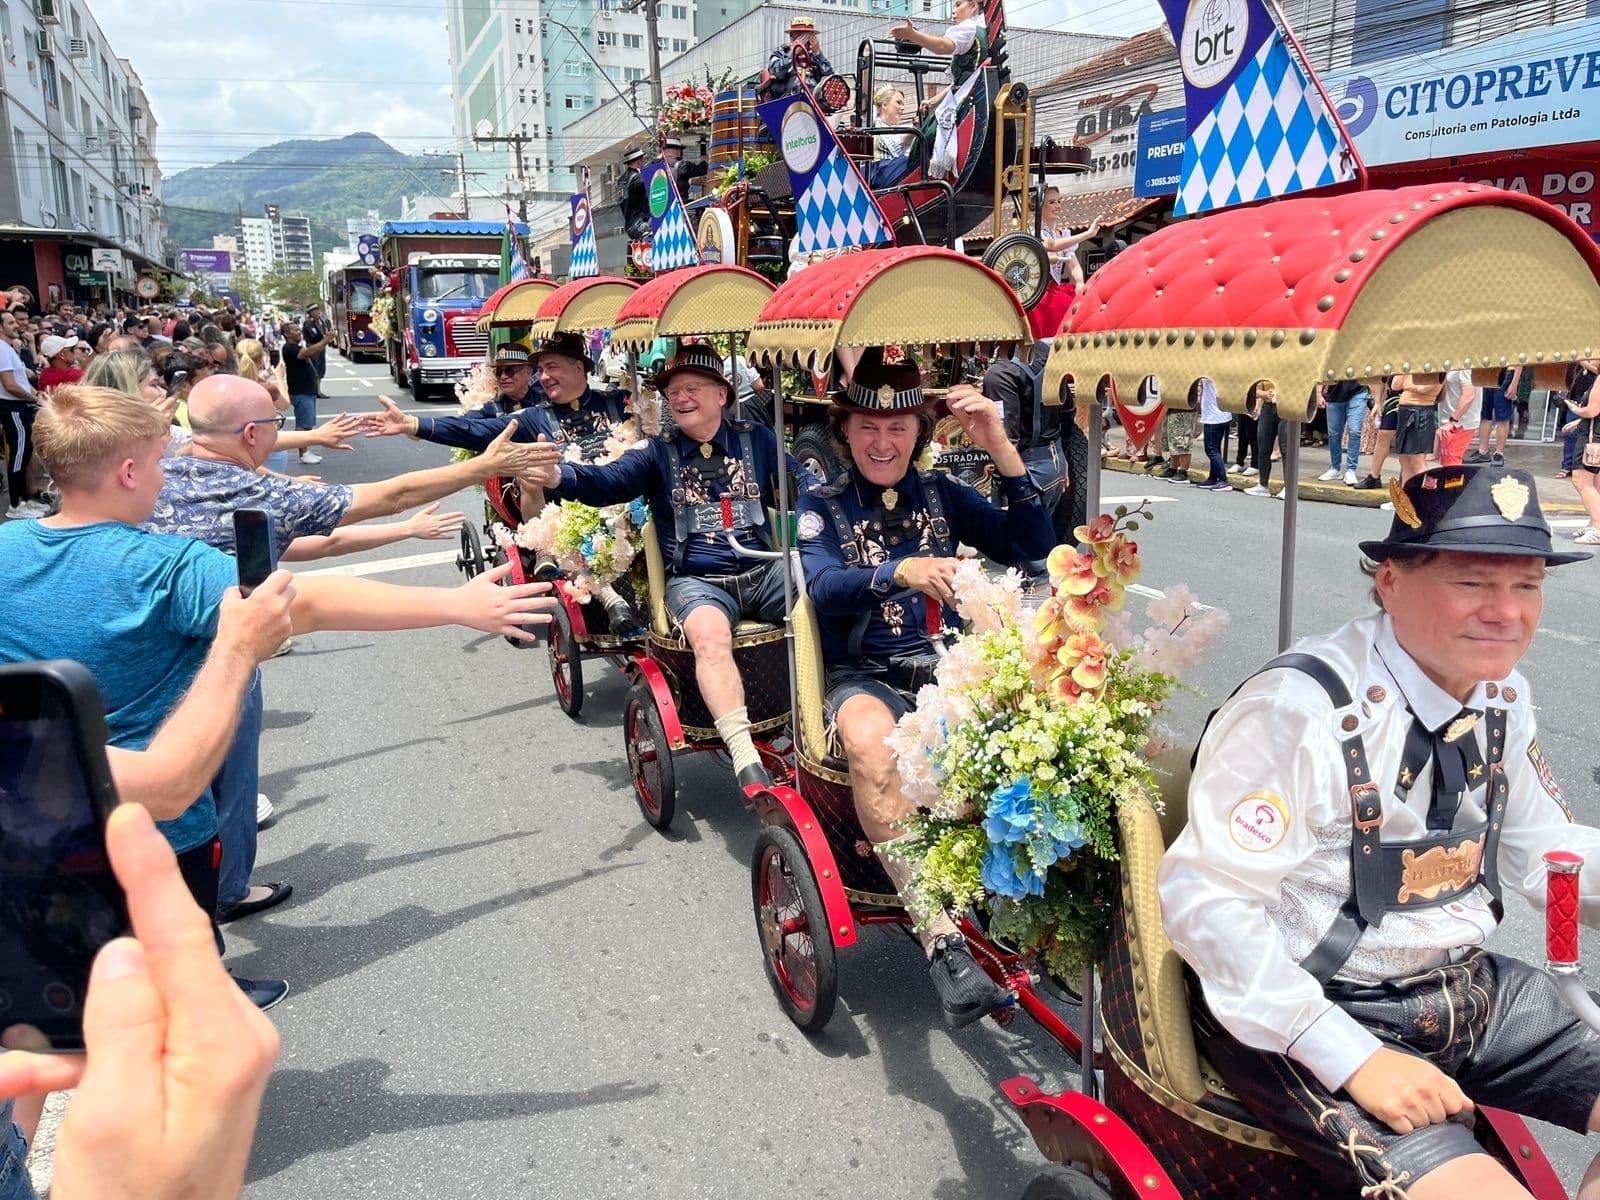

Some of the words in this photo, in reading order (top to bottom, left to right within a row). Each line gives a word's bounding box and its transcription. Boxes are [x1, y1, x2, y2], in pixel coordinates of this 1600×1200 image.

[1195, 22, 1235, 66] brt
[1385, 50, 1600, 119] CITOPREVE
[1405, 122, 1467, 141] Consultoria
[1470, 121, 1488, 132] em
[1491, 111, 1548, 129] Patologia
[1552, 107, 1581, 121] Ltda
[785, 134, 817, 152] intelbras
[1542, 171, 1595, 196] DO
[428, 259, 464, 268] Alfa
[1235, 815, 1272, 844] bradesco
